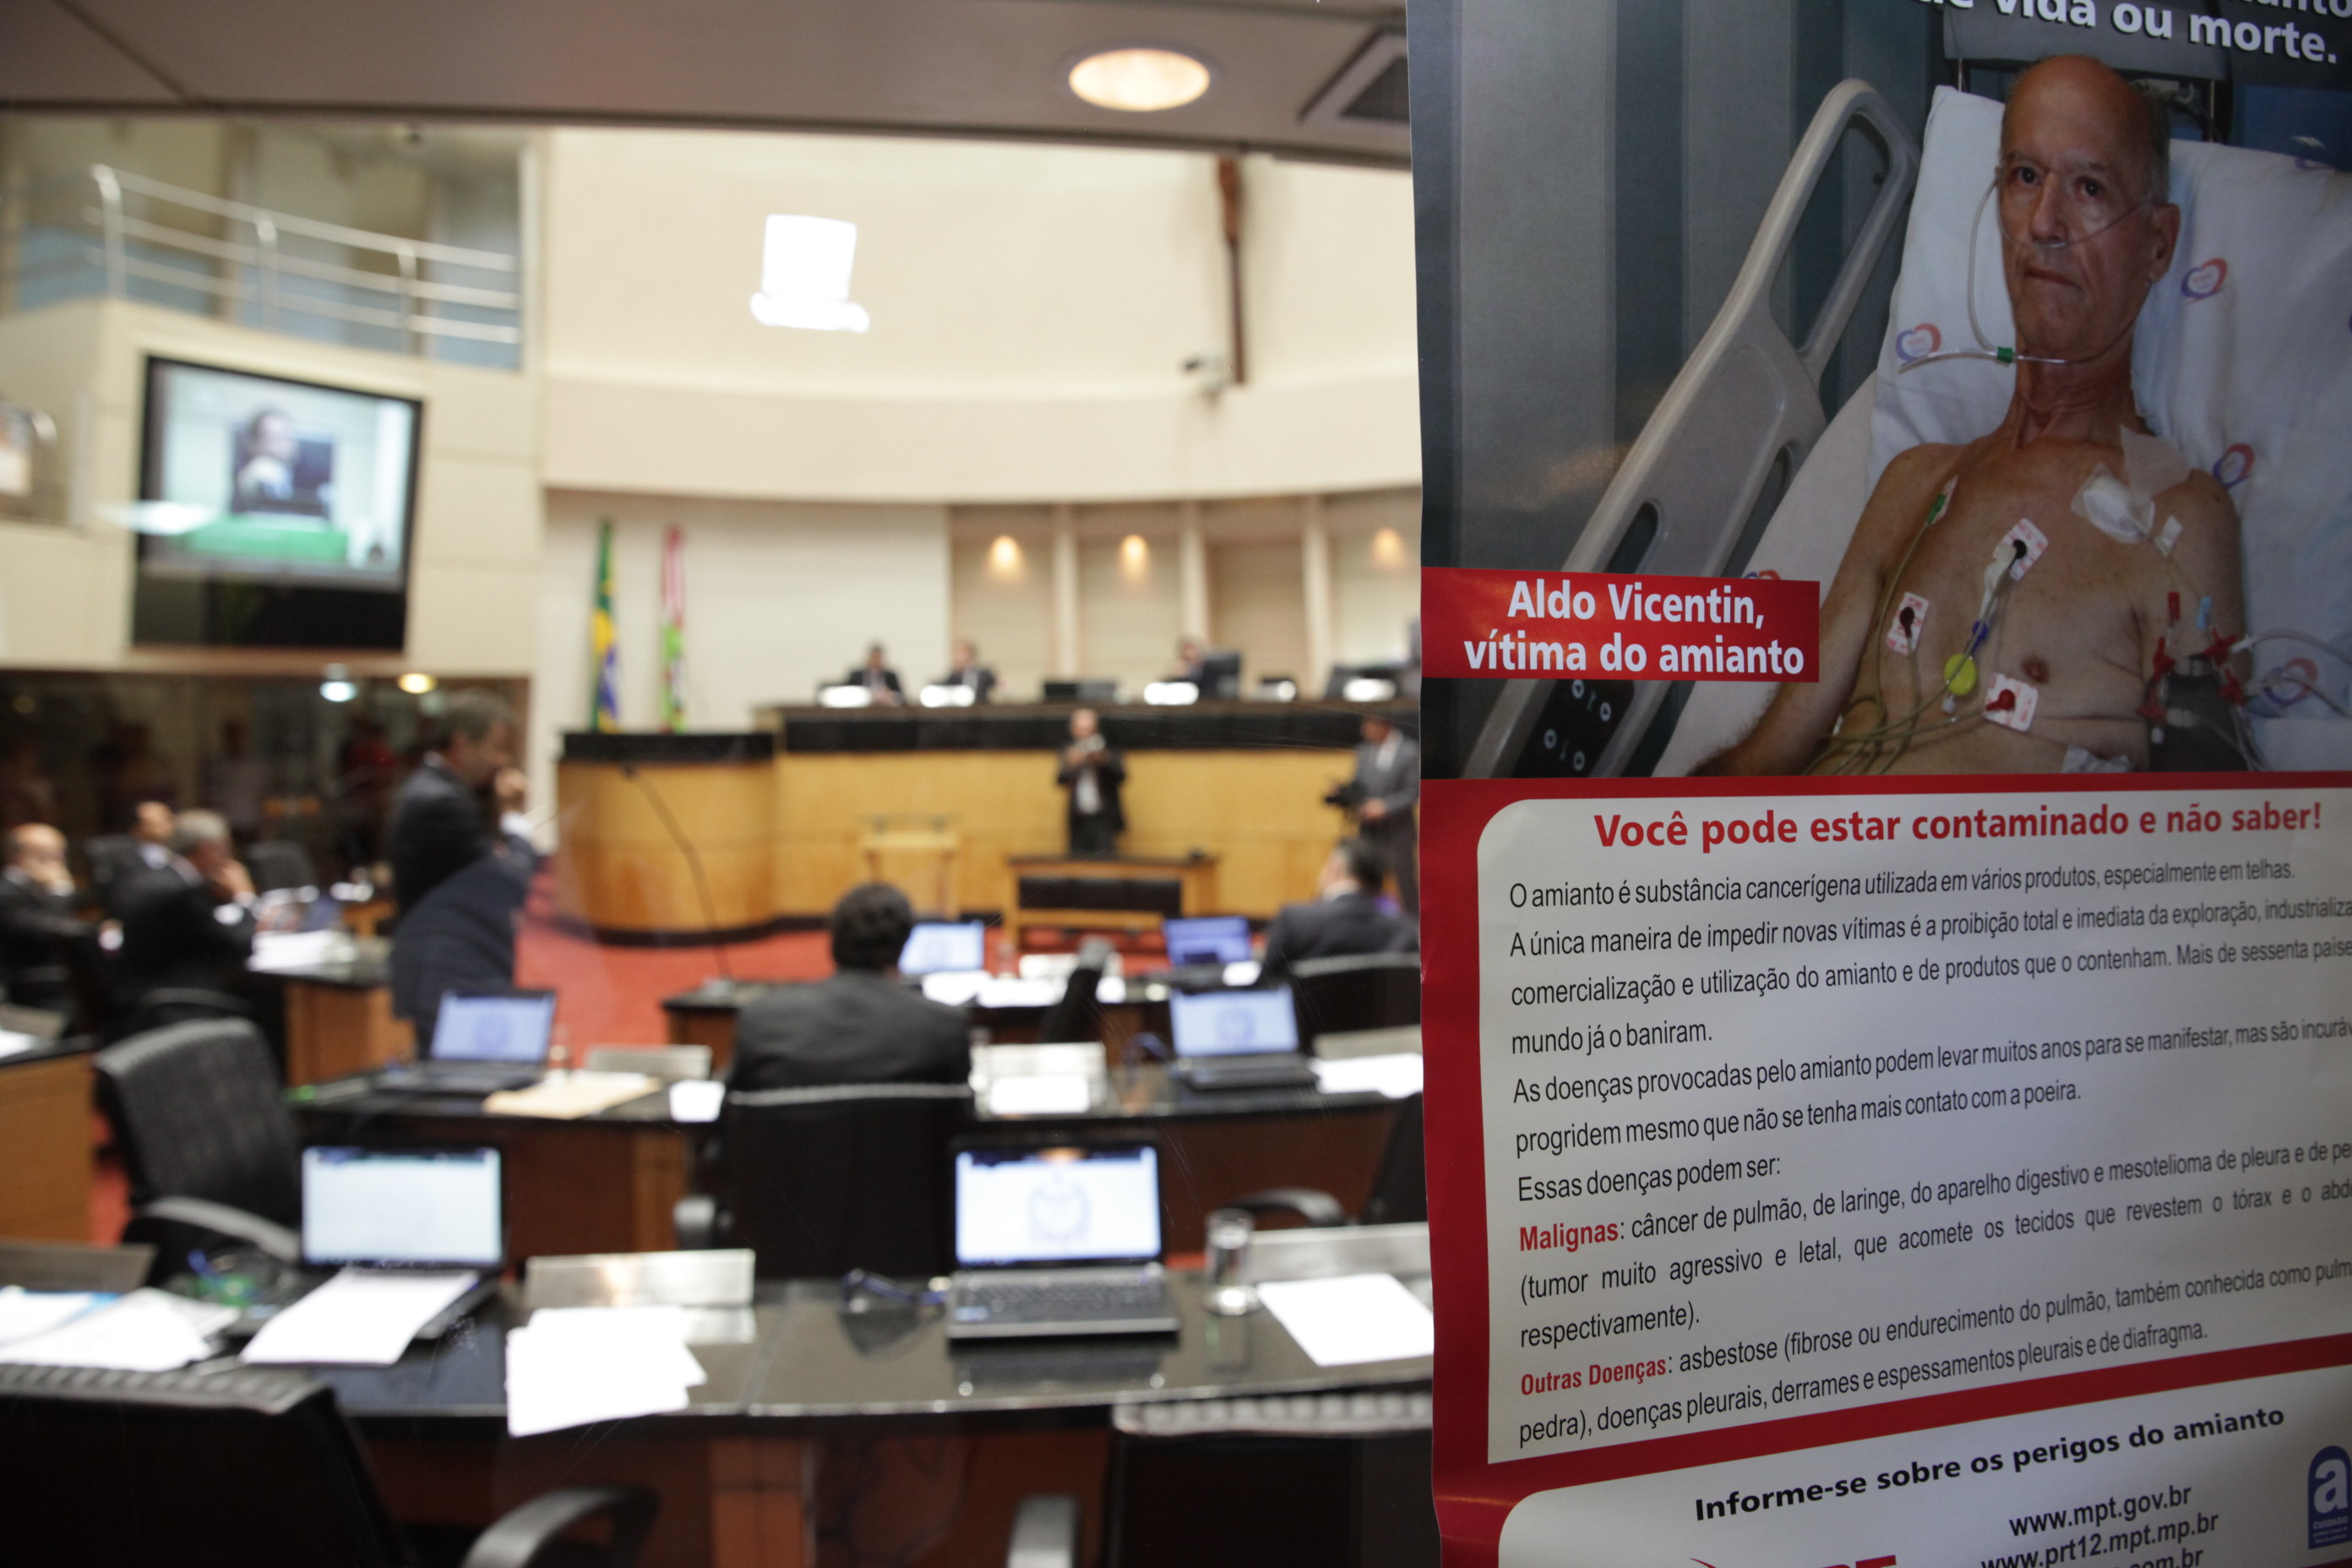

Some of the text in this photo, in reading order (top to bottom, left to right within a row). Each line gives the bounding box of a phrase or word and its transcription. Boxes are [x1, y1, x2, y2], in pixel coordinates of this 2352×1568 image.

[1992, 0, 2338, 64] vida ou morte.
[1507, 579, 1765, 629] Aldo Vicentin,
[1464, 629, 1805, 674] vítima do amianto
[1594, 801, 2322, 854] Você pode estar contaminado e não saber!
[1511, 860, 2295, 907] O amianto é substância cancerígena utilizada em vários produtos, especialmente em telhas.
[1511, 933, 1526, 956] A
[1531, 930, 1584, 956] única
[1592, 927, 1671, 952] maneira
[1678, 925, 1701, 949] de
[1708, 922, 1778, 952] impedir
[1783, 924, 1837, 943] novas
[1843, 917, 1905, 939] vítimas
[1911, 914, 1921, 937] é
[1926, 919, 1936, 936] a
[1941, 912, 2018, 940] proibição
[2023, 909, 2057, 931] total
[2063, 913, 2072, 929] e
[2077, 906, 2144, 928] imediata
[2149, 905, 2168, 925] da
[2173, 901, 2260, 928] exploração,
[1511, 974, 1675, 1005] comercialização
[1682, 977, 1693, 995] e
[1701, 967, 1789, 997] utilização
[1796, 965, 1819, 988] do
[1826, 962, 1897, 987] amianto
[1903, 965, 1913, 982] e
[1919, 958, 1940, 980] de
[1946, 956, 2019, 984] produtos
[2025, 957, 2055, 979] que
[2062, 956, 2072, 972] o
[2077, 948, 2171, 971] contenham.
[2177, 945, 2213, 965] Mais
[2219, 944, 2236, 962] de
[2242, 941, 2308, 961] sessenta
[1512, 1021, 1712, 1056] mundo já o baniram.
[1514, 1021, 2299, 1103] As doenças provocadas pelo amianto podem levar muitos anos para se manifestar, mas são
[1516, 1081, 2080, 1159] progridem mesmo que não se tenha mais contato com a poeira.
[1519, 1157, 1779, 1201] Essas doenças podem ser:
[1520, 1141, 2328, 1252] Malignas: câncer de pulmão, de laringe, do aparelho digestivo e mesotelioma de pleura e de
[1522, 1189, 2272, 1306] (tumor muito agressivo e letal, que acomete os tecidos que revestem tórax
[1522, 1301, 1699, 1349] respectivamente).
[1522, 1267, 2311, 1395] Outras Doenças: asbestose (fibrose ou endurecimento do pulmão, também conhecida como
[1520, 1323, 2207, 1449] pedra), doenças pleurais, derrames e espessamentos pleurais e de diafragma.
[1696, 1408, 2284, 1521] Informe-se sobre os perigos do amianto
[2009, 1484, 2192, 1536] www.mpt.gov.br
